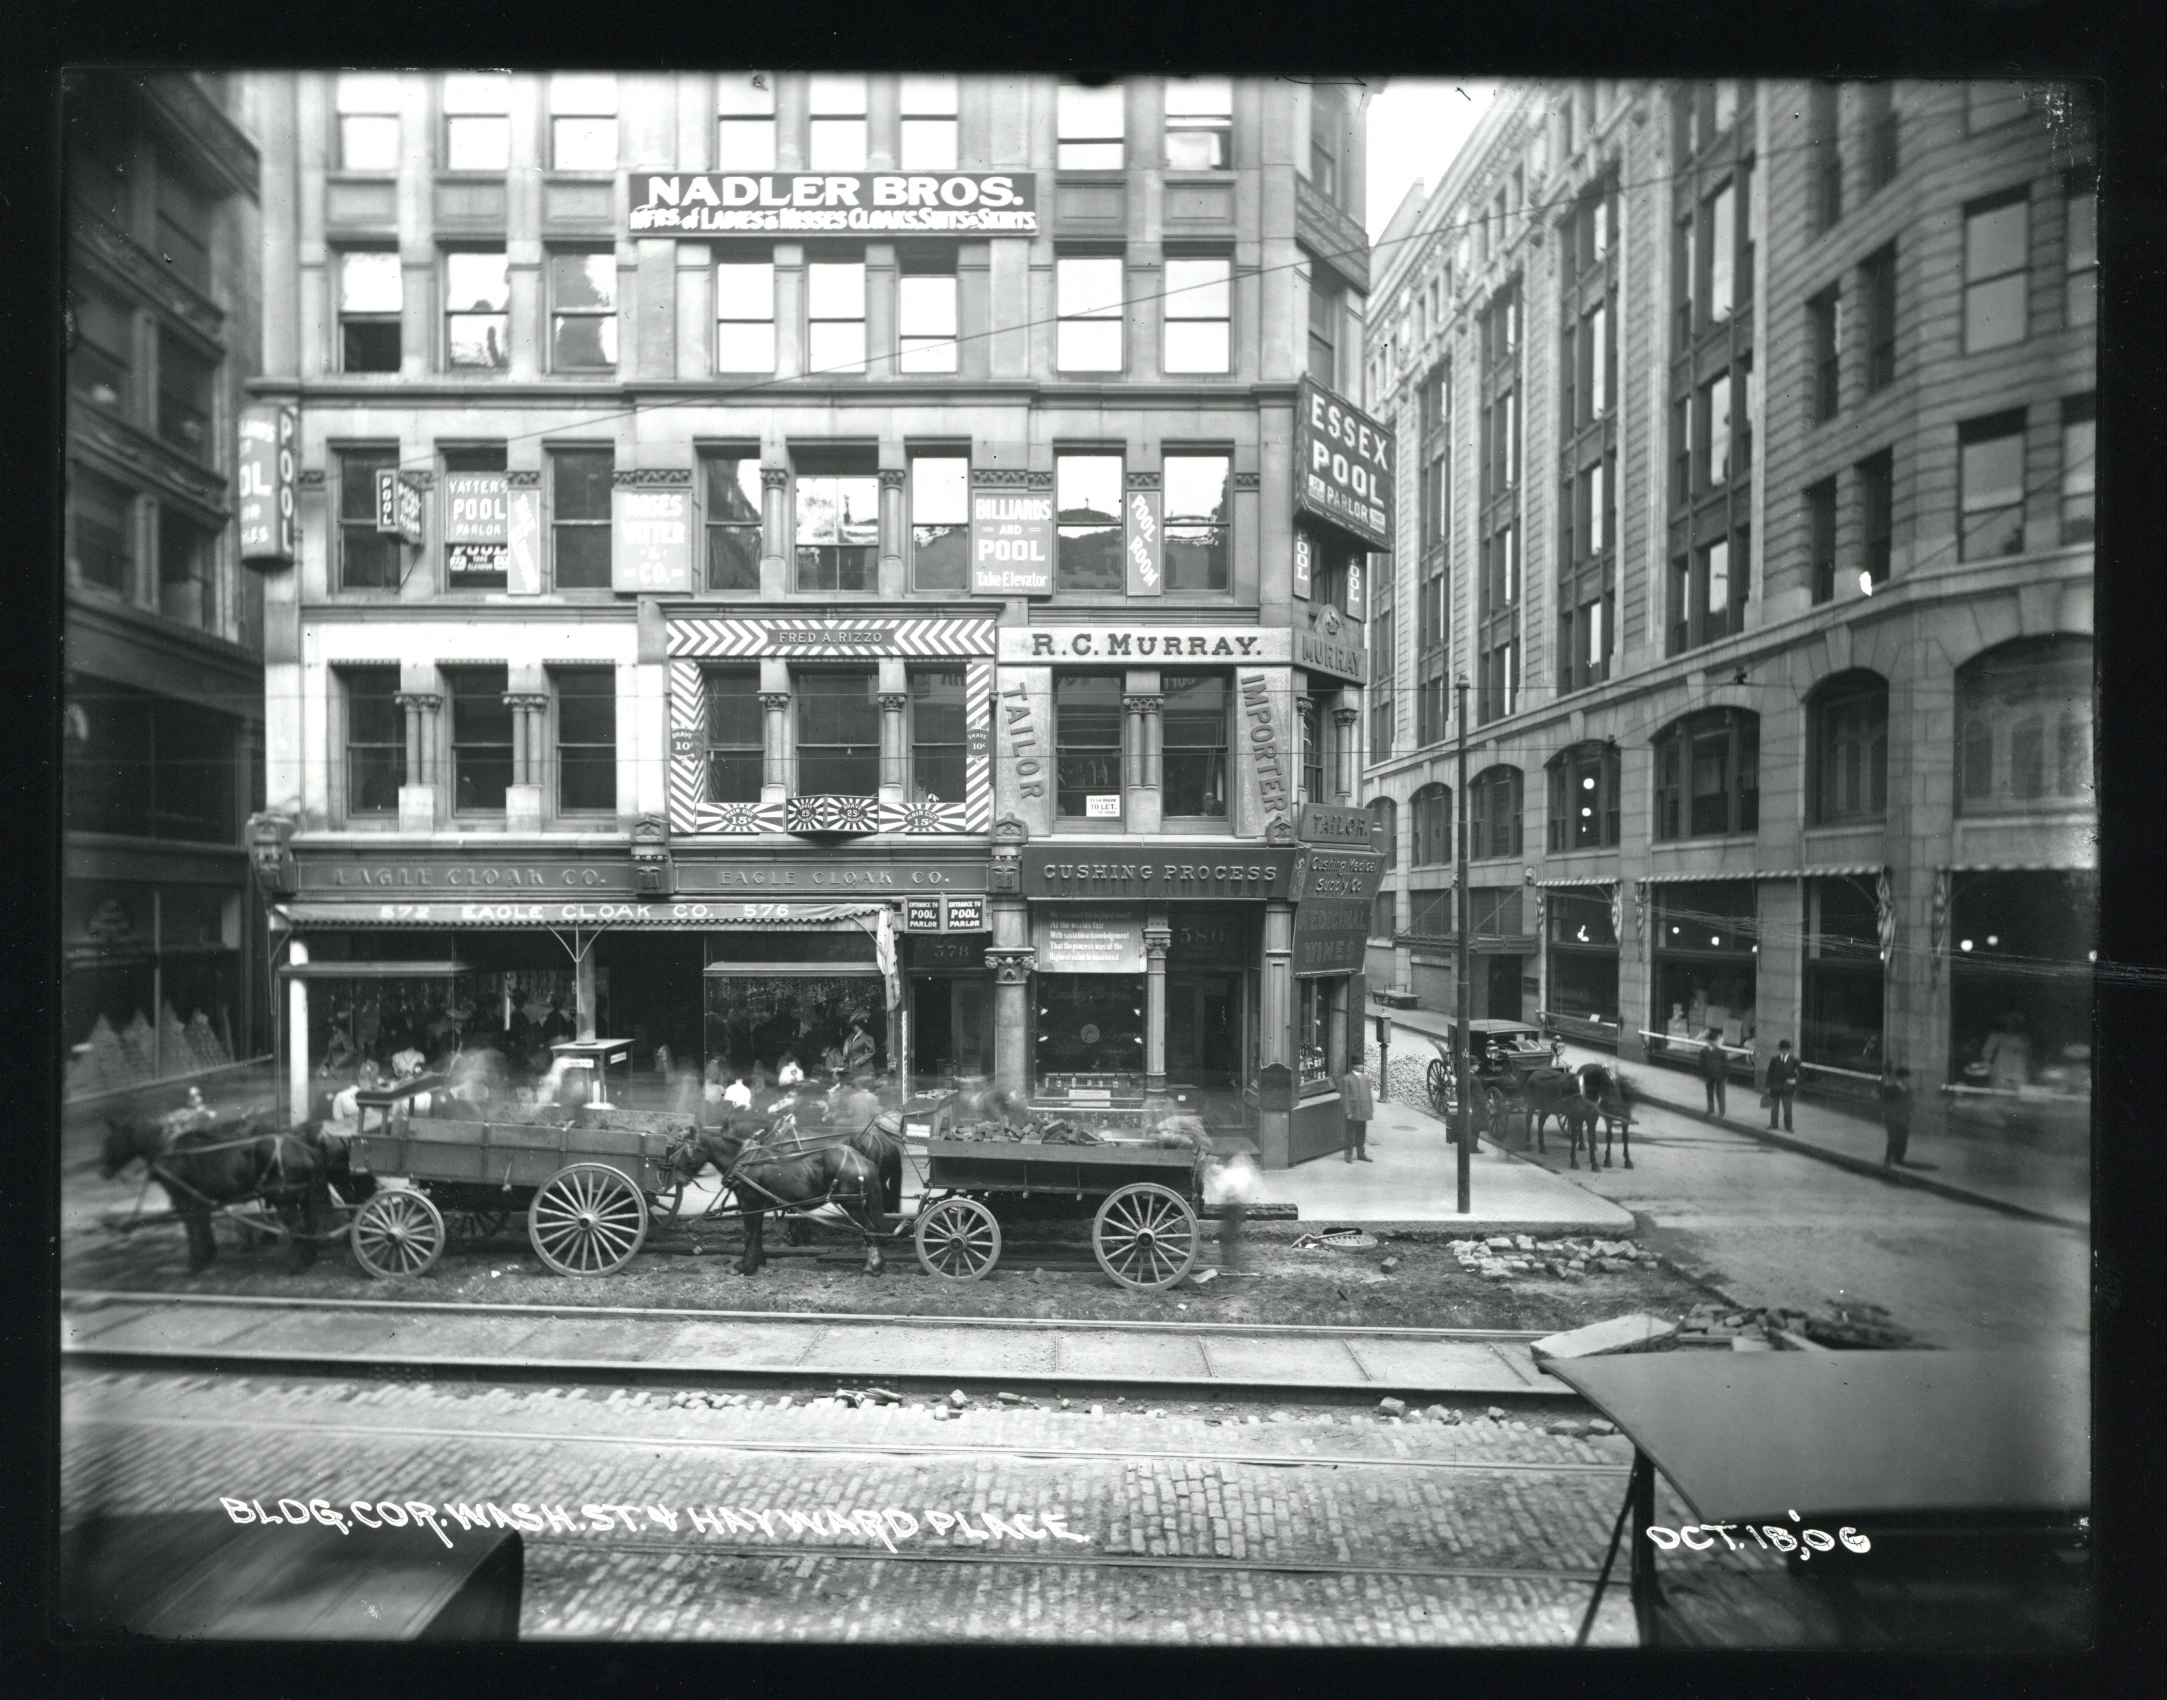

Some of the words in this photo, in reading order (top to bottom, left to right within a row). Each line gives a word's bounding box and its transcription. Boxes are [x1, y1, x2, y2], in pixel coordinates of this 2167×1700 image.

[648, 176, 860, 206] NADLER
[873, 176, 1024, 207] BROS.
[1311, 393, 1388, 470] ESSEX
[280, 411, 294, 553] POOL
[1313, 439, 1385, 509] POOL
[449, 479, 508, 495] YATTER'S
[382, 477, 392, 525] POOL
[453, 498, 507, 520] POOL
[975, 499, 1051, 520] BILLIARDS
[1327, 485, 1369, 525] PARLOR
[1131, 494, 1156, 543] POOL
[456, 524, 501, 536] PARLOR
[999, 525, 1022, 536] AND
[979, 540, 1045, 562] POOL
[1297, 529, 1308, 581] POOL
[1129, 536, 1159, 587] ROOM
[639, 562, 671, 584] CO.
[976, 571, 1001, 588] Take
[1003, 571, 1048, 588] Elevator
[779, 632, 819, 644] FRED
[838, 632, 882, 644] RIZZO
[1107, 633, 1262, 656] MURRAY.
[1302, 635, 1361, 677] MURRAY
[671, 731, 693, 739] SHAVE
[1003, 682, 1044, 800] TAILOR
[1241, 674, 1288, 815] IMPORTER
[725, 808, 740, 819] HAIR
[742, 808, 754, 817] CUT
[907, 810, 924, 821] HAIR
[924, 810, 938, 820] CUT
[1313, 813, 1369, 837] TAILOR.
[1043, 864, 1154, 880] CUSHING
[1163, 864, 1278, 882] PROCESS
[1311, 856, 1347, 876] Cushing
[1348, 858, 1379, 873] Medical
[336, 867, 433, 887] EAGLE
[447, 867, 545, 887] CLOAK
[561, 867, 607, 886] CO.
[719, 870, 797, 887] EAGLE
[812, 870, 893, 887] CLOAK
[911, 870, 951, 886] CO.
[1316, 878, 1349, 896] Supply
[1350, 878, 1363, 892] Co
[380, 905, 430, 919] 572
[461, 905, 544, 919] EAGLE
[562, 904, 653, 919] CLOAK
[672, 904, 714, 918] CO.
[743, 903, 789, 918] 576
[911, 909, 937, 919] POOL
[950, 908, 979, 919] POOL
[1298, 909, 1367, 932] MEDICINAL
[909, 920, 937, 928] PARLOR
[949, 920, 980, 928] PARLOR
[1050, 921, 1059, 929] At
[1060, 921, 1070, 929] the
[1050, 931, 1063, 939] With
[1179, 927, 1225, 945] 580
[934, 945, 969, 958] 578
[1050, 941, 1063, 950] That
[1063, 941, 1073, 950] the
[1072, 942, 1095, 952] process
[1095, 943, 1106, 951] was
[1106, 941, 1113, 951] of
[1113, 942, 1123, 951] the
[1304, 940, 1357, 963] WINES
